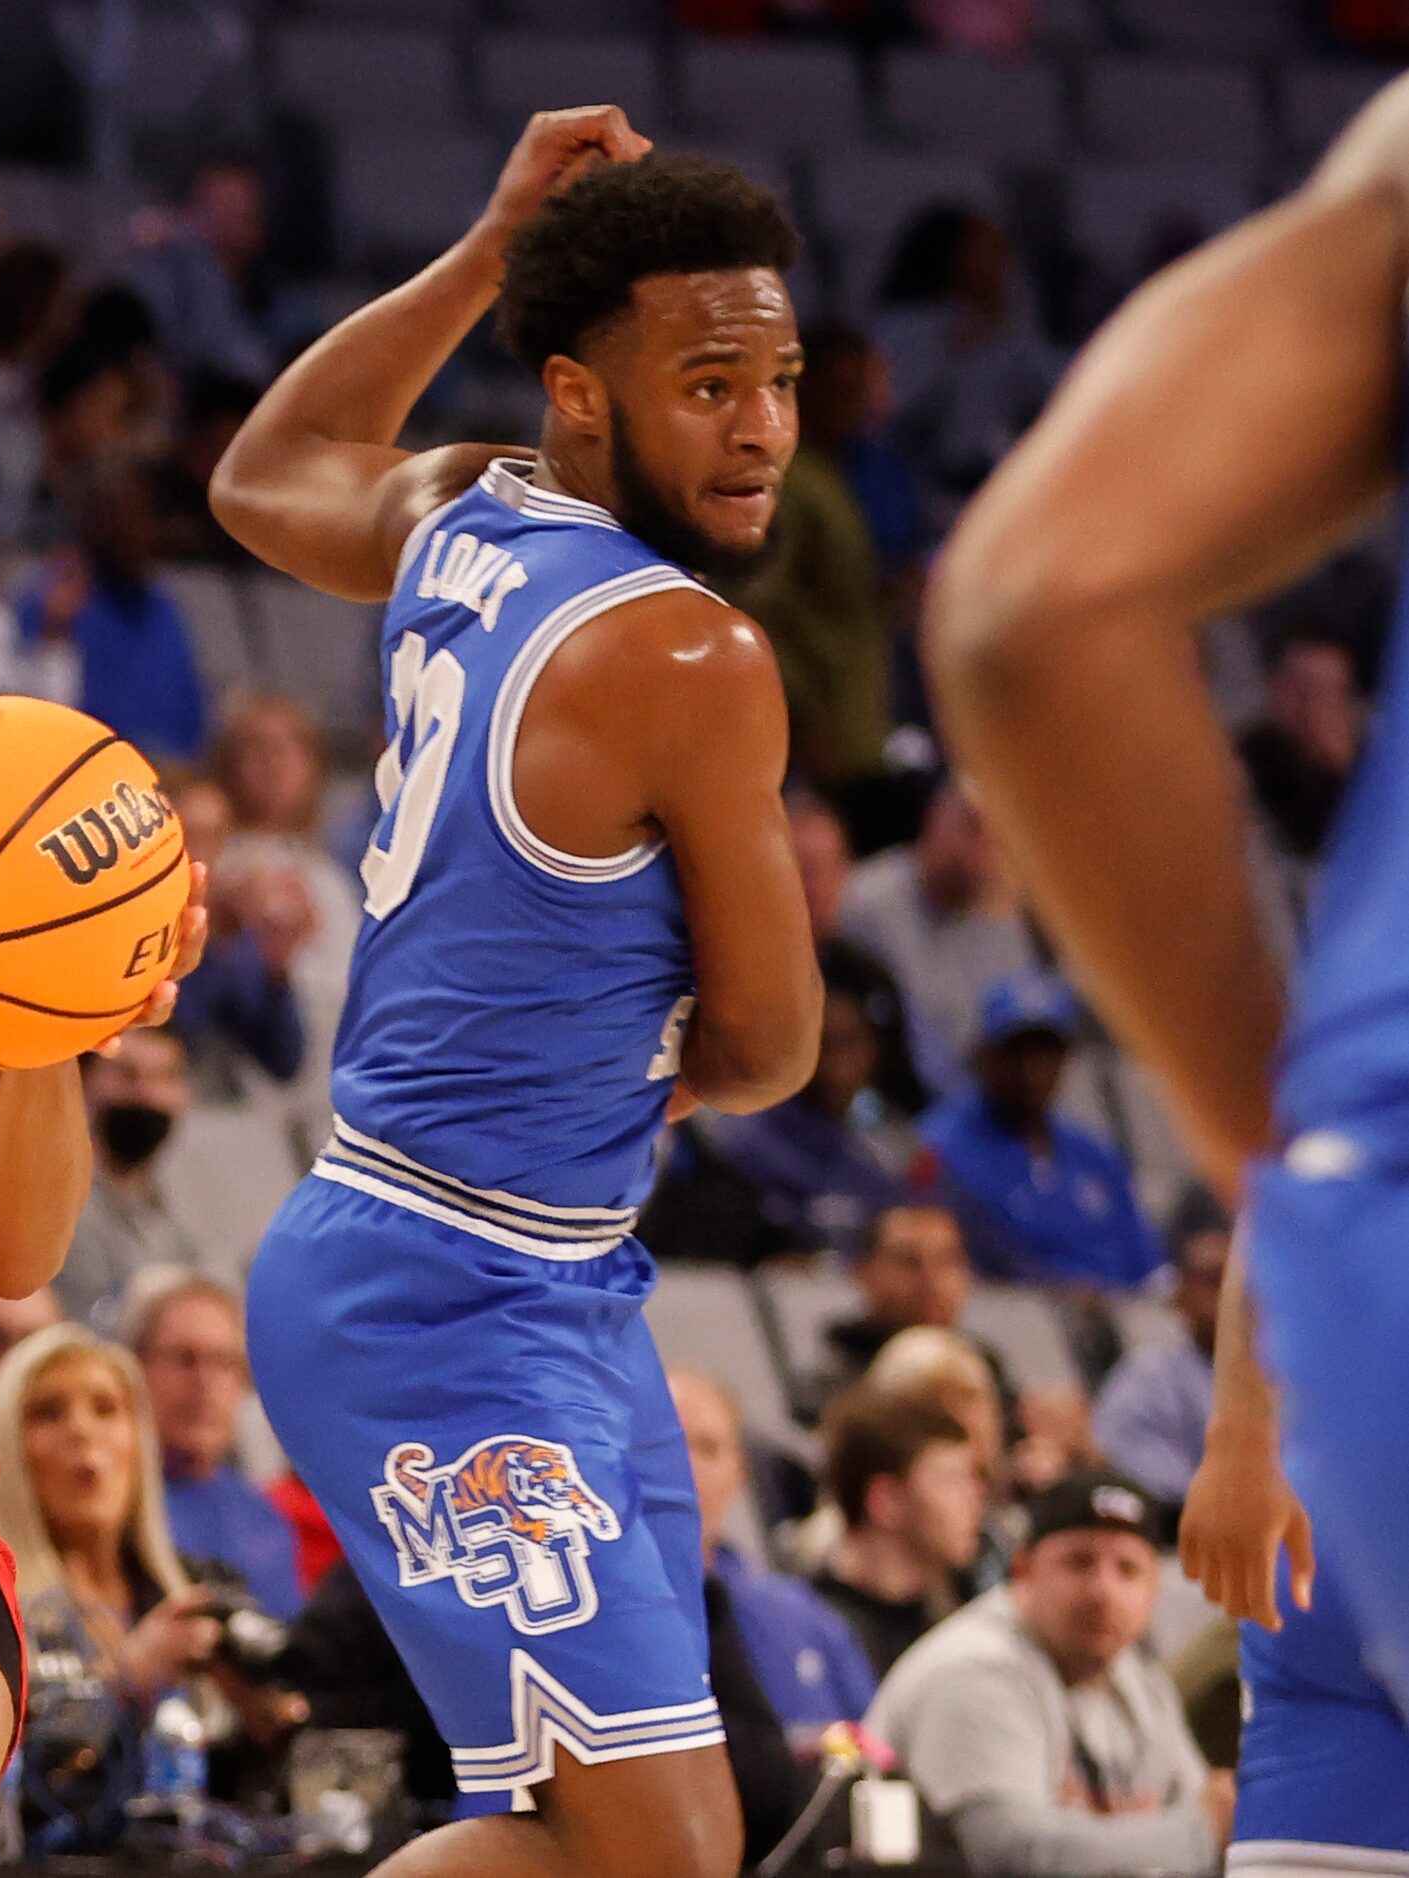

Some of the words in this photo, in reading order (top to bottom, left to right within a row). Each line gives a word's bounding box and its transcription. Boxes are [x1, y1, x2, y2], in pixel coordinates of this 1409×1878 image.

[36, 781, 173, 885] Wils
[122, 911, 184, 979] EV
[369, 1473, 599, 1636] MSU
